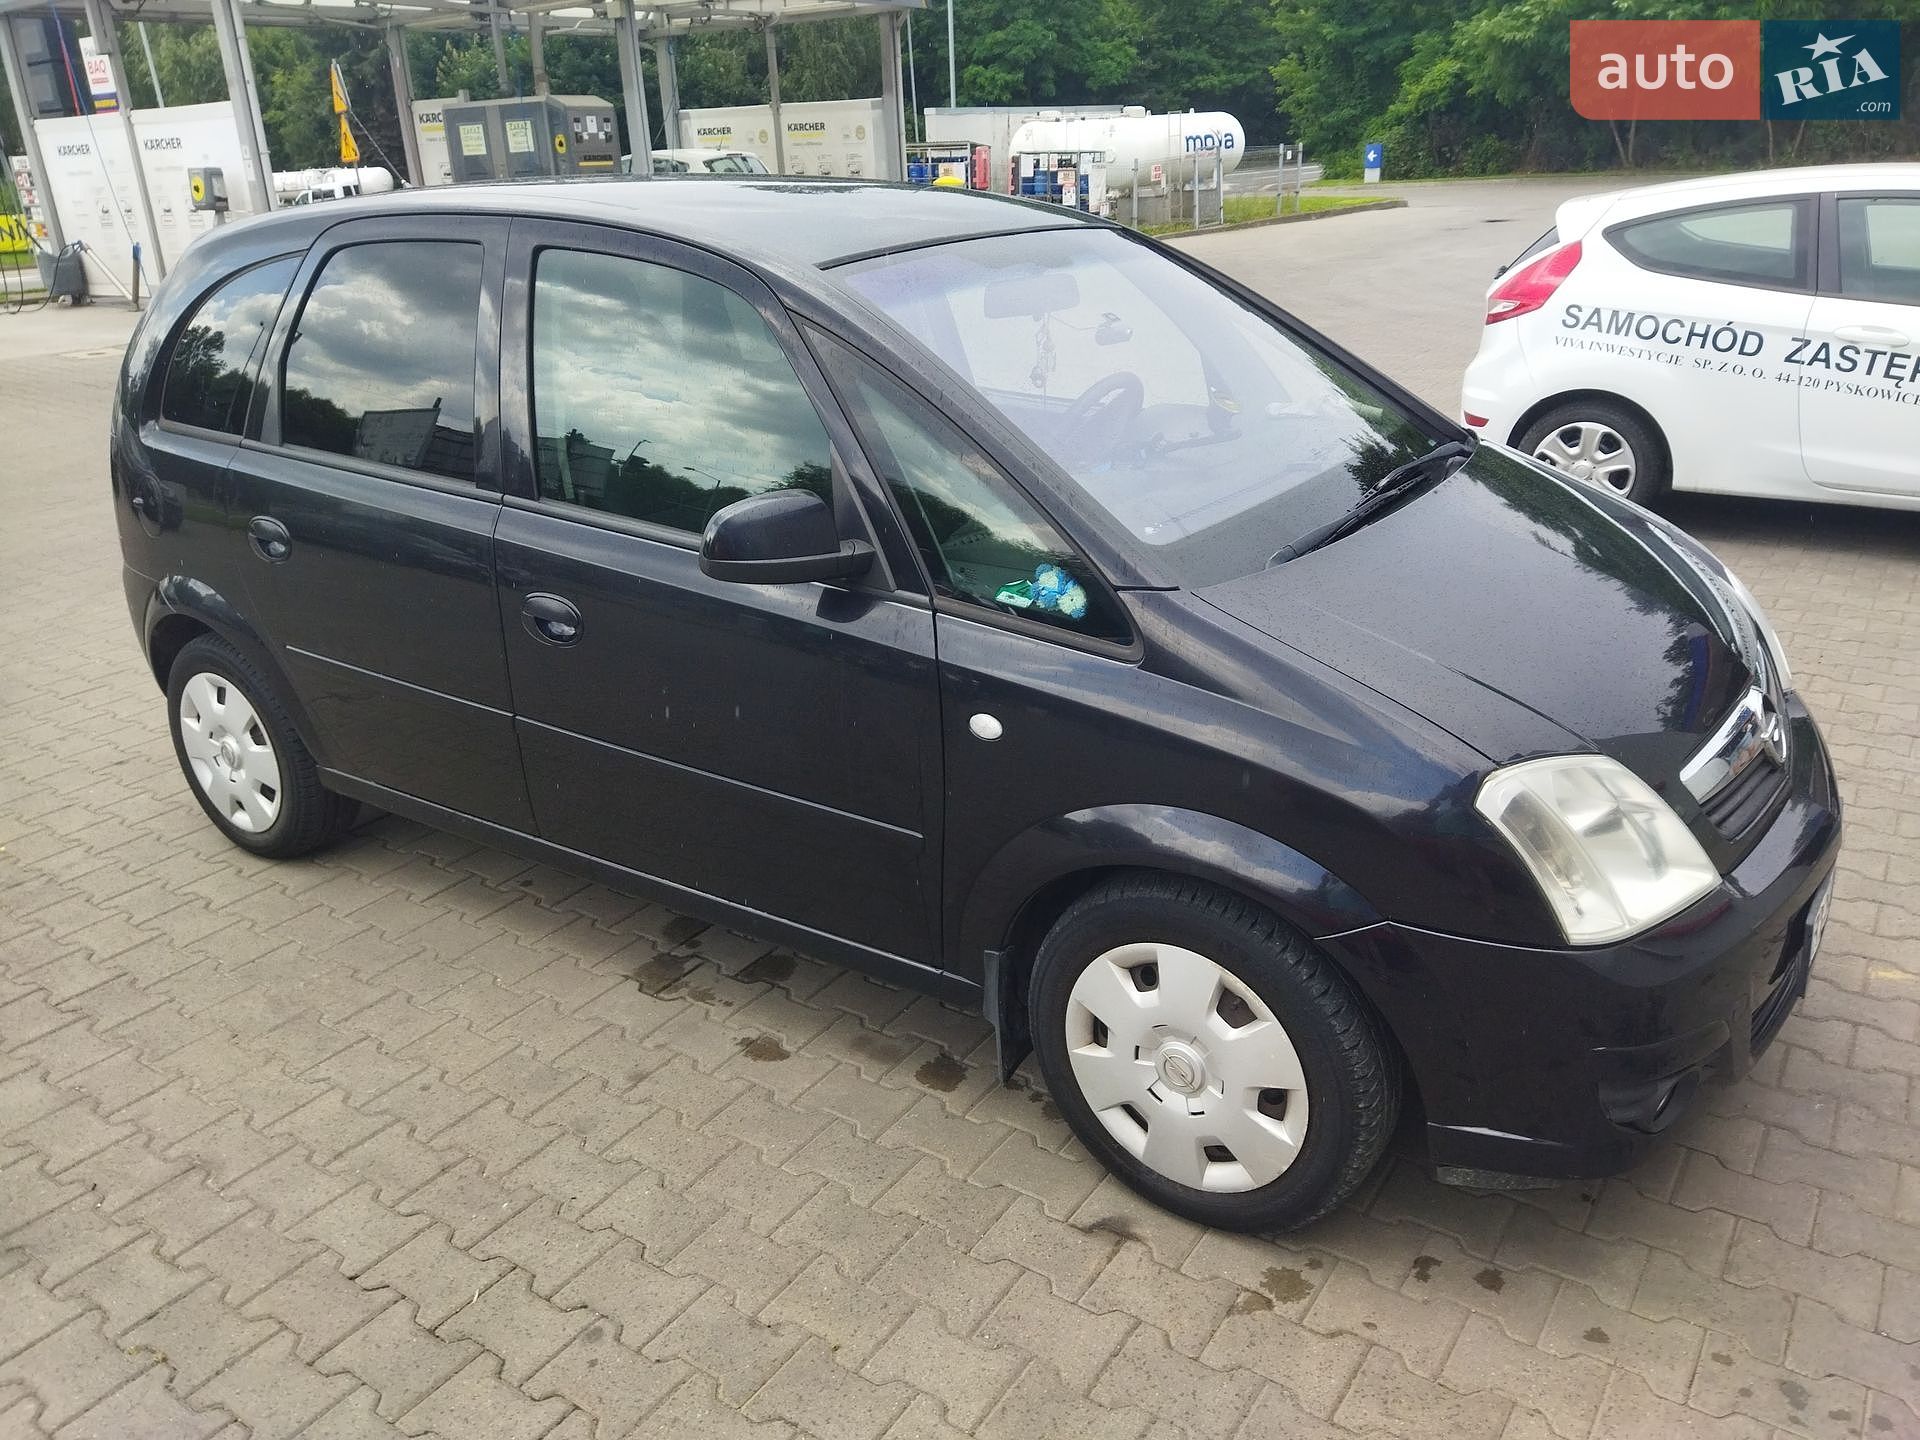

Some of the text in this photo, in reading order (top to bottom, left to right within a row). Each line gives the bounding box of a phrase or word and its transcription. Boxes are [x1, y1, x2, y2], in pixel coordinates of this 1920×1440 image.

[1561, 303, 1764, 357] SAMOCHÓD
[1554, 335, 1585, 350] VIVA
[1588, 340, 1685, 367] INWESTYCJE
[1692, 357, 1714, 372] SP.
[1718, 360, 1730, 373] Z
[1774, 371, 1821, 389] 44-120
